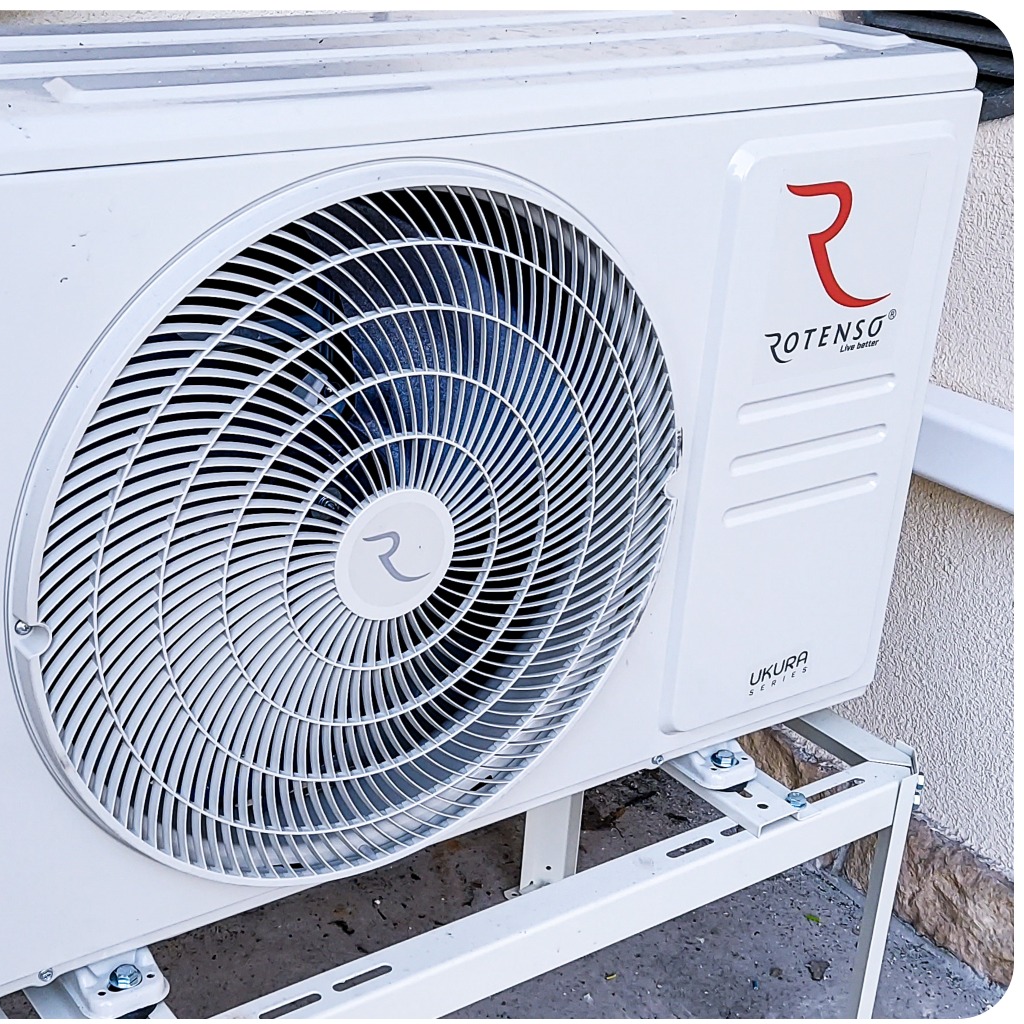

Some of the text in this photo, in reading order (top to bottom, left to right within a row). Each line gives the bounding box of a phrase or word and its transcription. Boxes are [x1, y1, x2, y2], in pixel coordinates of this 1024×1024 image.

[786, 181, 891, 308] R
[839, 339, 880, 353] Live better
[748, 666, 808, 696] SERIES
[749, 650, 808, 686] UKURA
